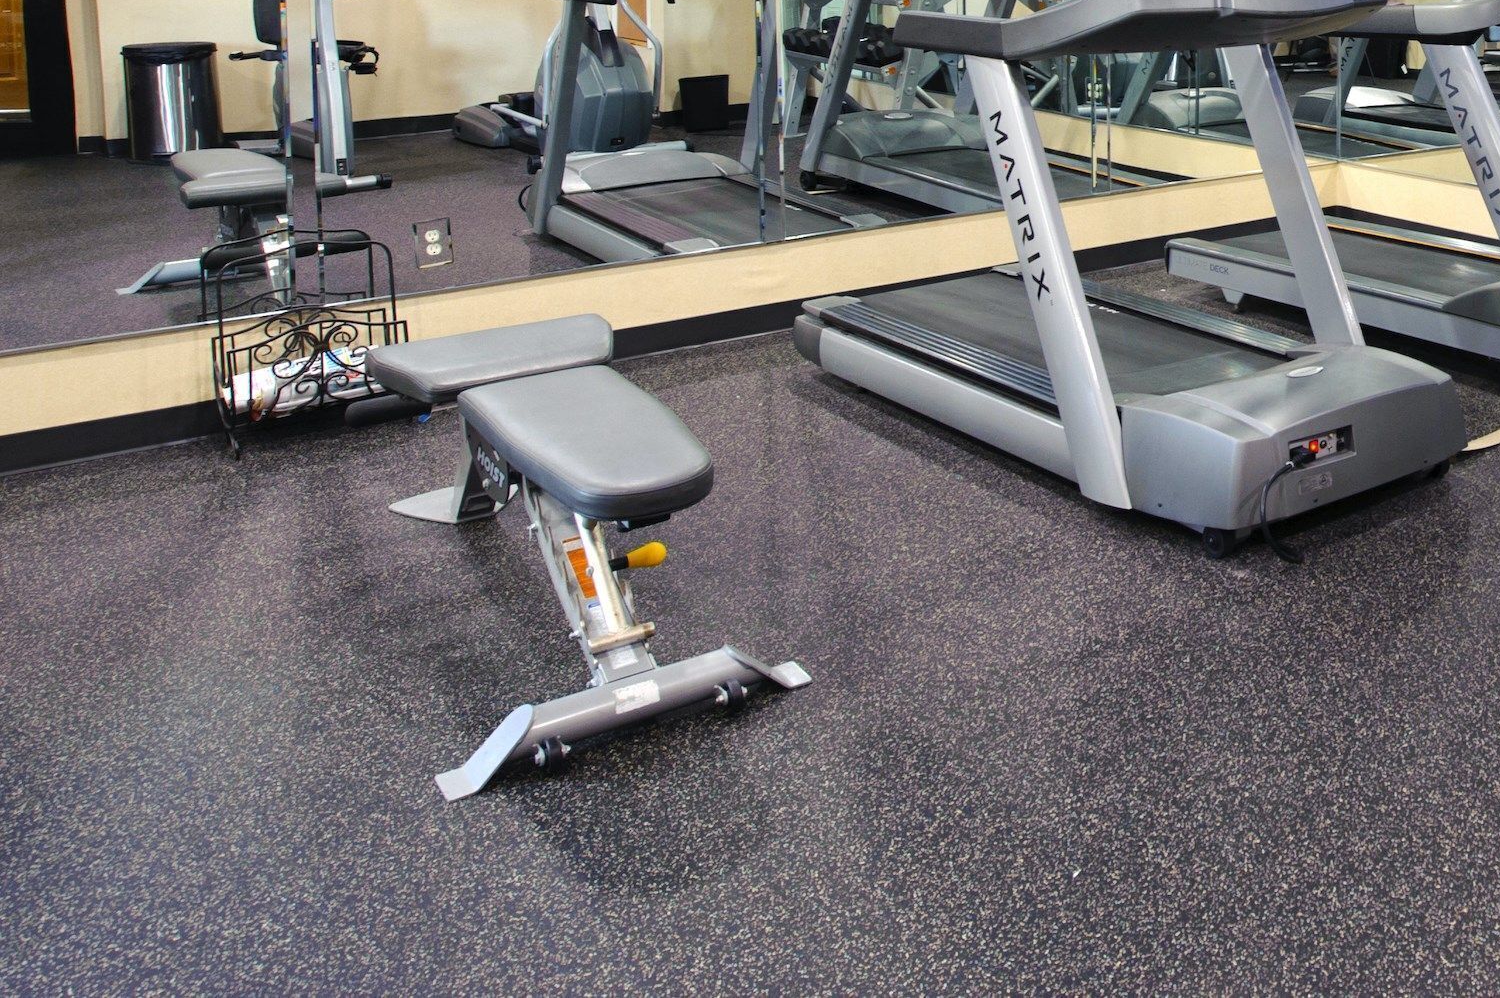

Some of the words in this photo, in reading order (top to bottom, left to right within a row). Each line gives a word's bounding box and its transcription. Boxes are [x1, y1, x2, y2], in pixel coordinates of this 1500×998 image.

[989, 110, 1050, 301] MATRIX
[1209, 264, 1229, 275] DECK
[477, 446, 505, 488] HOIST
